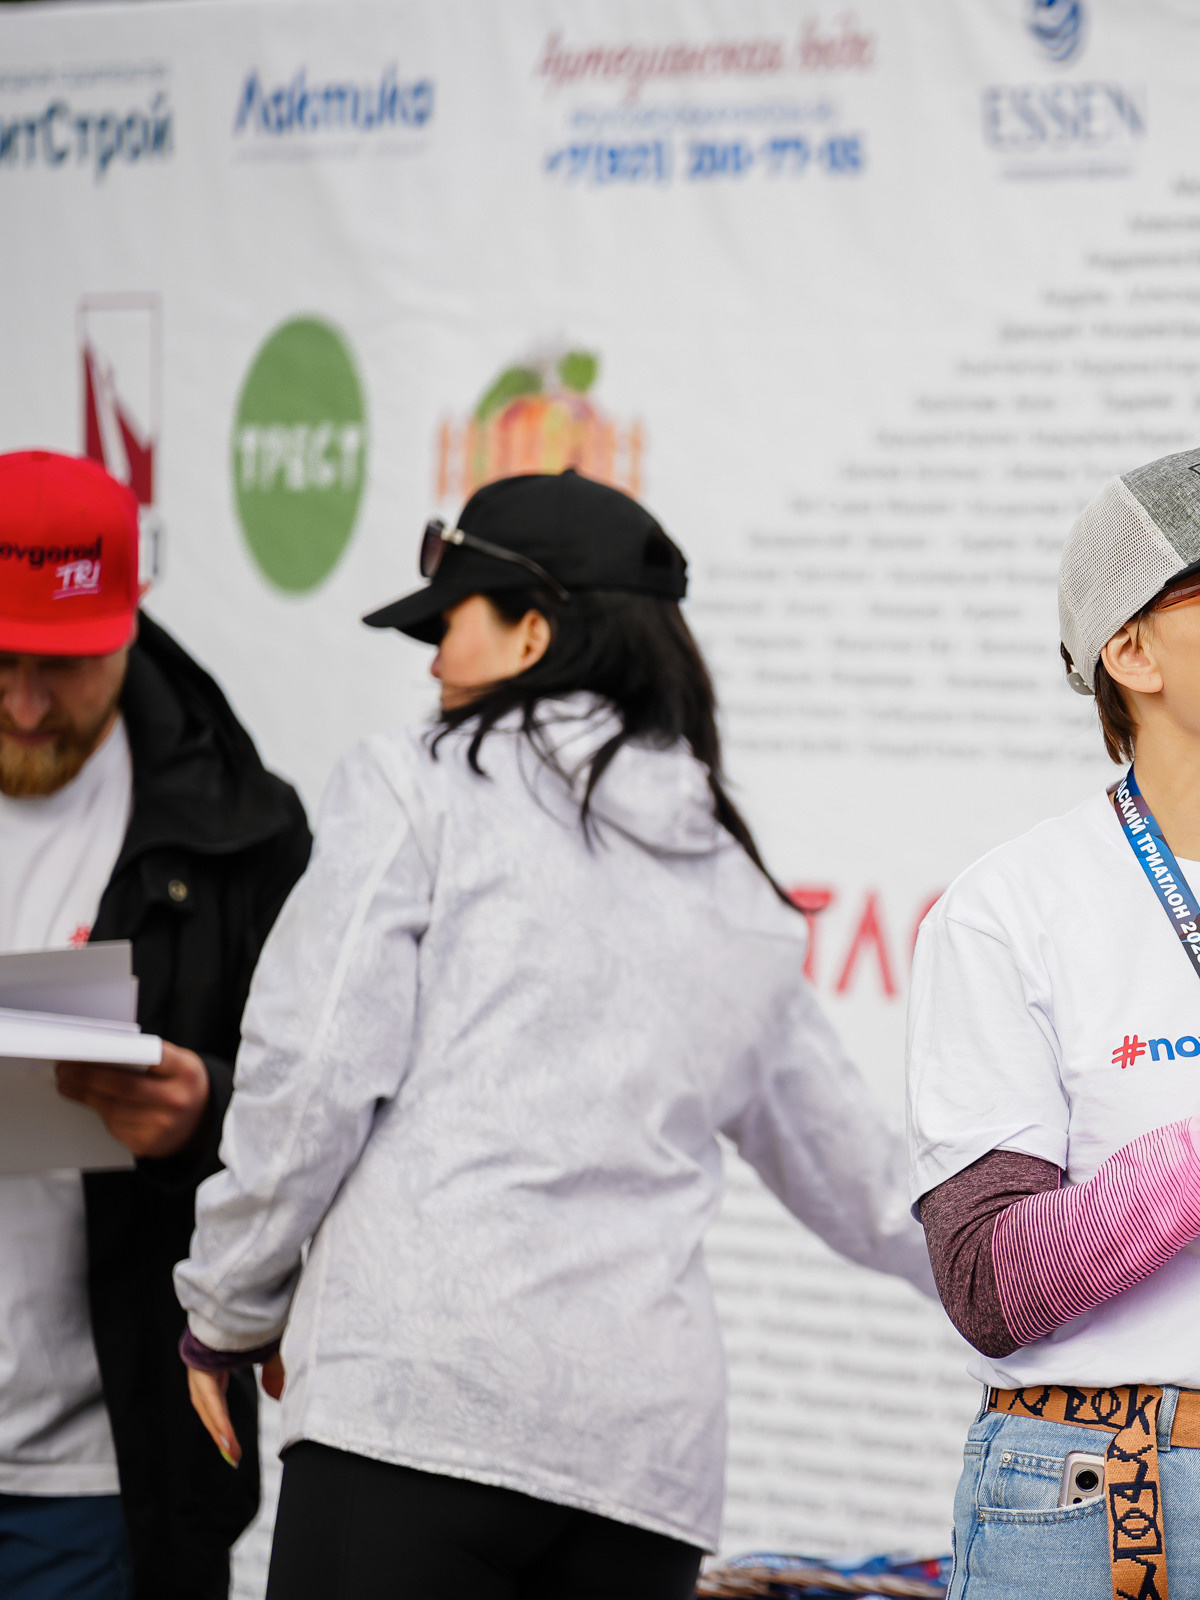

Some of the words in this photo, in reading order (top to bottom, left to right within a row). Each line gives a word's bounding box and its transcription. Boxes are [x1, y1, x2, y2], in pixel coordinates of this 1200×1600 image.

[982, 82, 1146, 150] ESSEN
[233, 423, 366, 491] ТРЕСТ
[1136, 832, 1192, 920] ТРИАТЛОН
